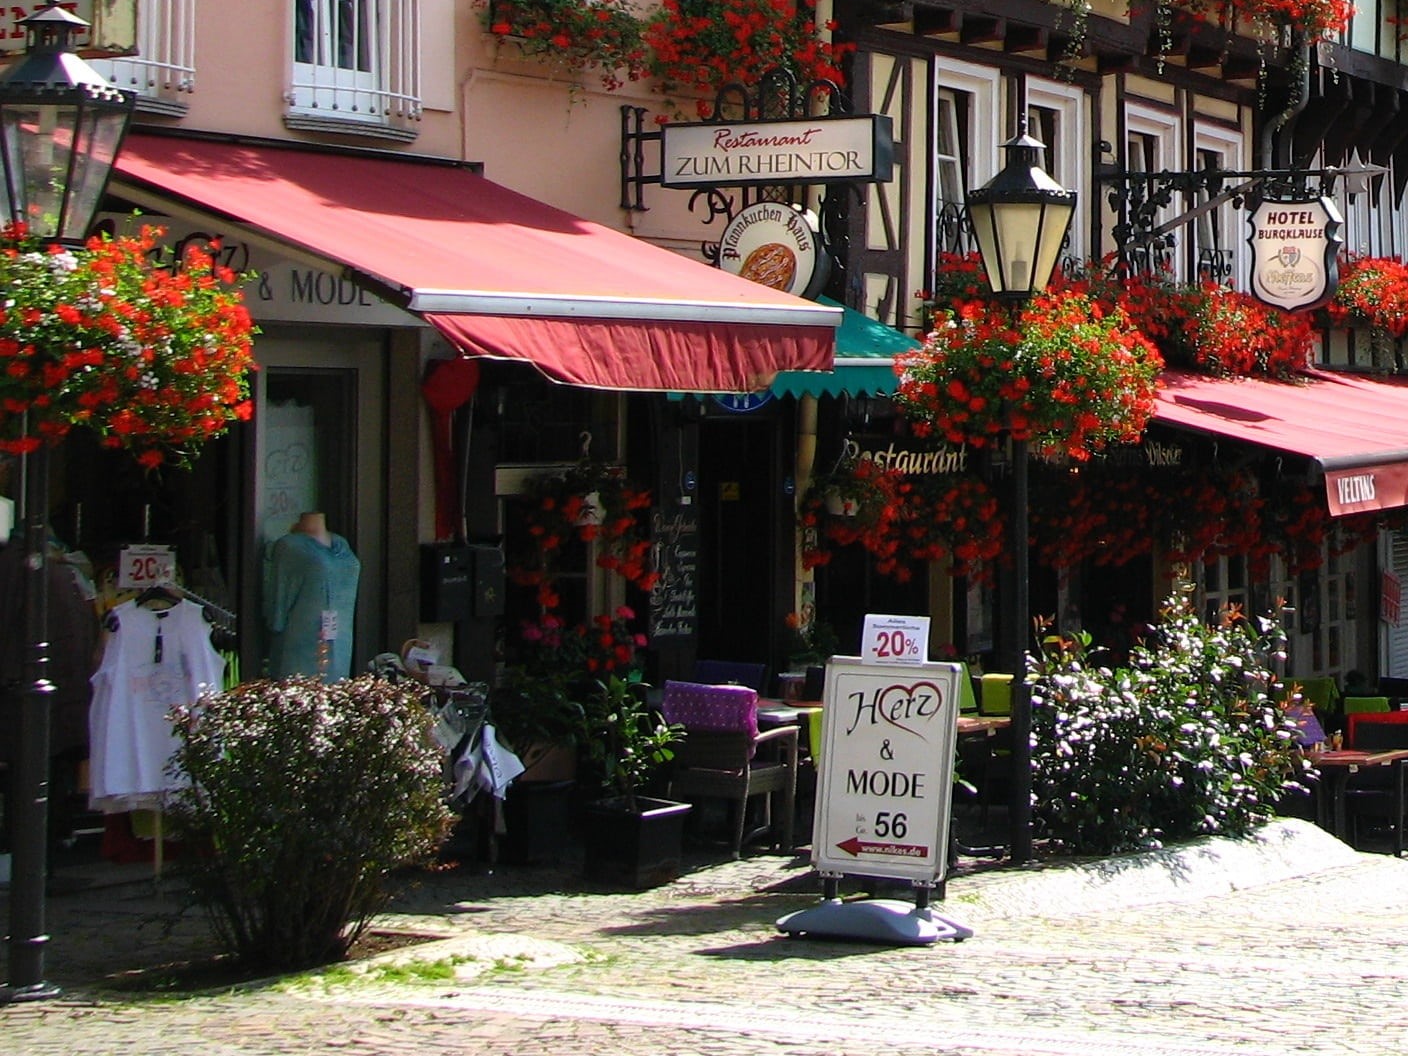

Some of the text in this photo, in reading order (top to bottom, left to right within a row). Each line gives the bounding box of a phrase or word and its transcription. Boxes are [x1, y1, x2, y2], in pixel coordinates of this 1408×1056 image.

[713, 128, 823, 152] Restaurant
[675, 150, 864, 177] ZUM RHEINTOR
[1267, 211, 1315, 225] HOTEL
[722, 204, 812, 262] Pfannkuchen Haus
[1258, 228, 1324, 241] BURGKLAUSE
[258, 270, 274, 301] &
[1337, 474, 1375, 504] VELTINS
[871, 630, 919, 657] -20%
[847, 686, 938, 736] Herz
[879, 738, 894, 761] &
[847, 769, 925, 799] MODE
[875, 811, 907, 838] 56
